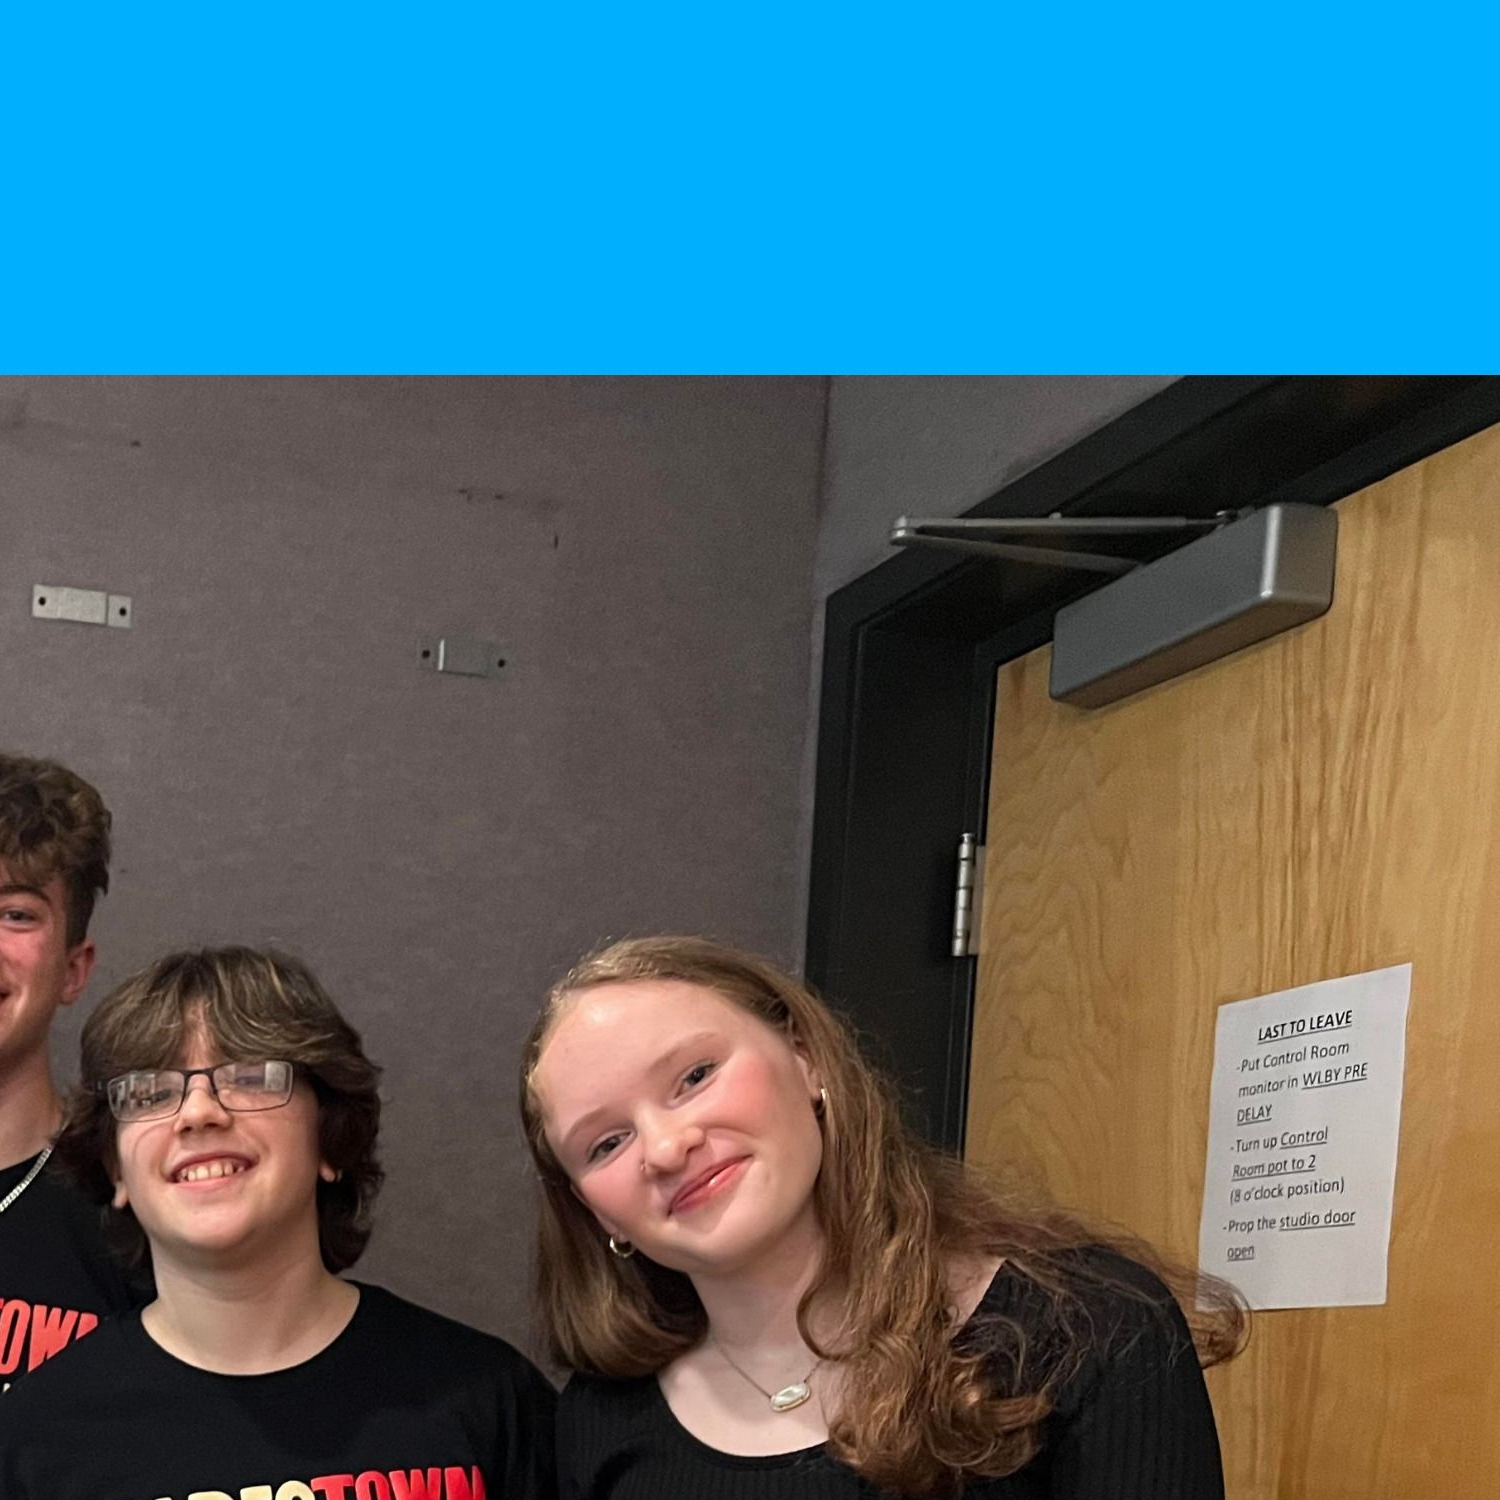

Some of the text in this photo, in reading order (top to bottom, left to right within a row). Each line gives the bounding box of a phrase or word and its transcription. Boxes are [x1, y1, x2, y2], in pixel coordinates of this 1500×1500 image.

[1258, 1010, 1352, 1042] LAST TO LEAVE
[1263, 1047, 1306, 1069] Control
[1311, 1042, 1350, 1060] Room
[1238, 1062, 1368, 1098] monitor in WLBY PRE
[1237, 1104, 1273, 1124] DELAY
[1263, 1135, 1277, 1151] up
[1280, 1126, 1328, 1147] Control
[1233, 1154, 1316, 1179] Room pot to 2
[1230, 1187, 1241, 1204] (8
[1287, 1178, 1345, 1199] position)
[1257, 1215, 1276, 1230] the
[1279, 1210, 1320, 1228] studio
[1324, 1208, 1356, 1226] door
[1227, 1245, 1255, 1261] open
